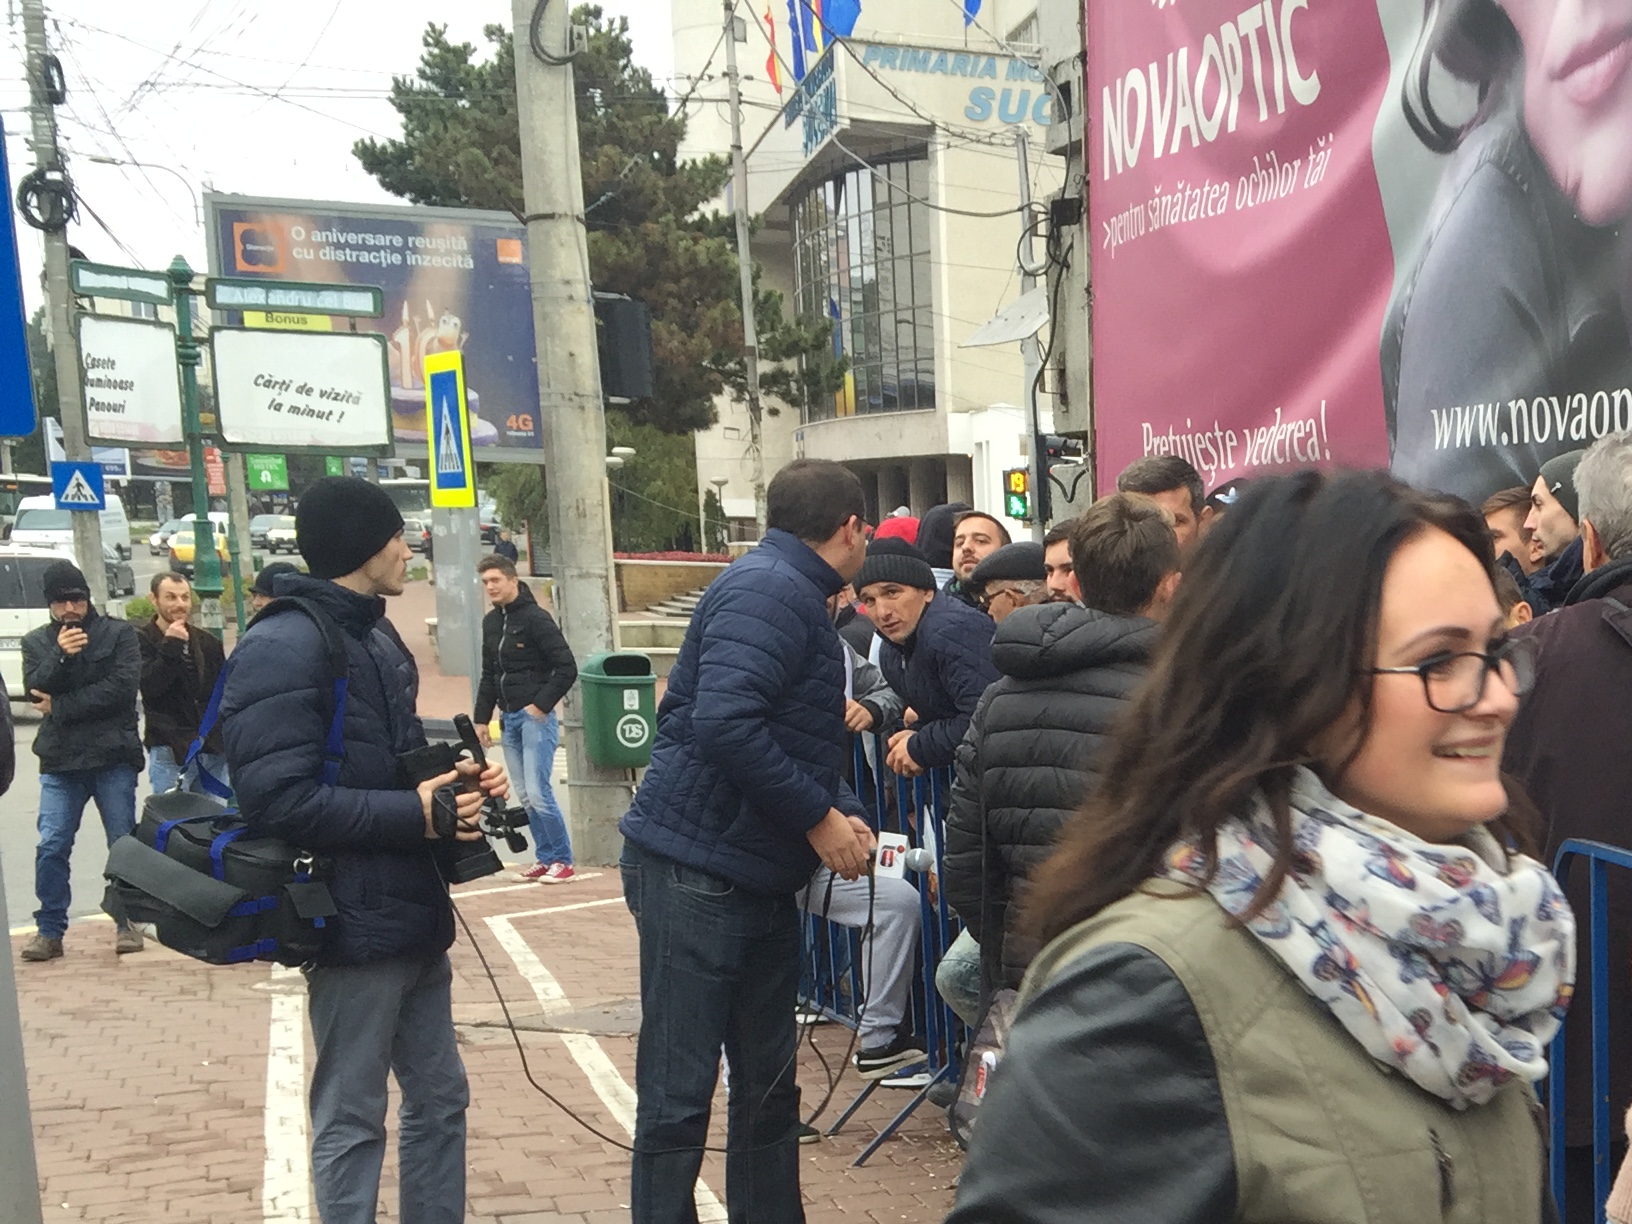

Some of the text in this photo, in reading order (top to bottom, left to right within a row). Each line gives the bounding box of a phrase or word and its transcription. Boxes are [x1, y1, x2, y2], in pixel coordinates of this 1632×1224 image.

[862, 44, 998, 80] PRIMARIA
[1102, 0, 1322, 181] NOVAOPTIC
[1148, 179, 1230, 232] sănătatea
[1235, 150, 1301, 210] ochilor
[1303, 132, 1334, 189] tăi
[290, 225, 306, 241] O
[310, 228, 403, 247] aniversare
[292, 247, 314, 260] cu
[264, 312, 308, 325] Bonus
[84, 352, 116, 371] Casete
[295, 381, 315, 397] de
[318, 387, 363, 406] vizită
[88, 397, 127, 414] Panouri
[267, 398, 283, 412] la
[287, 400, 334, 422] minut
[506, 413, 534, 430] 4G
[1243, 399, 1332, 467] vederea!
